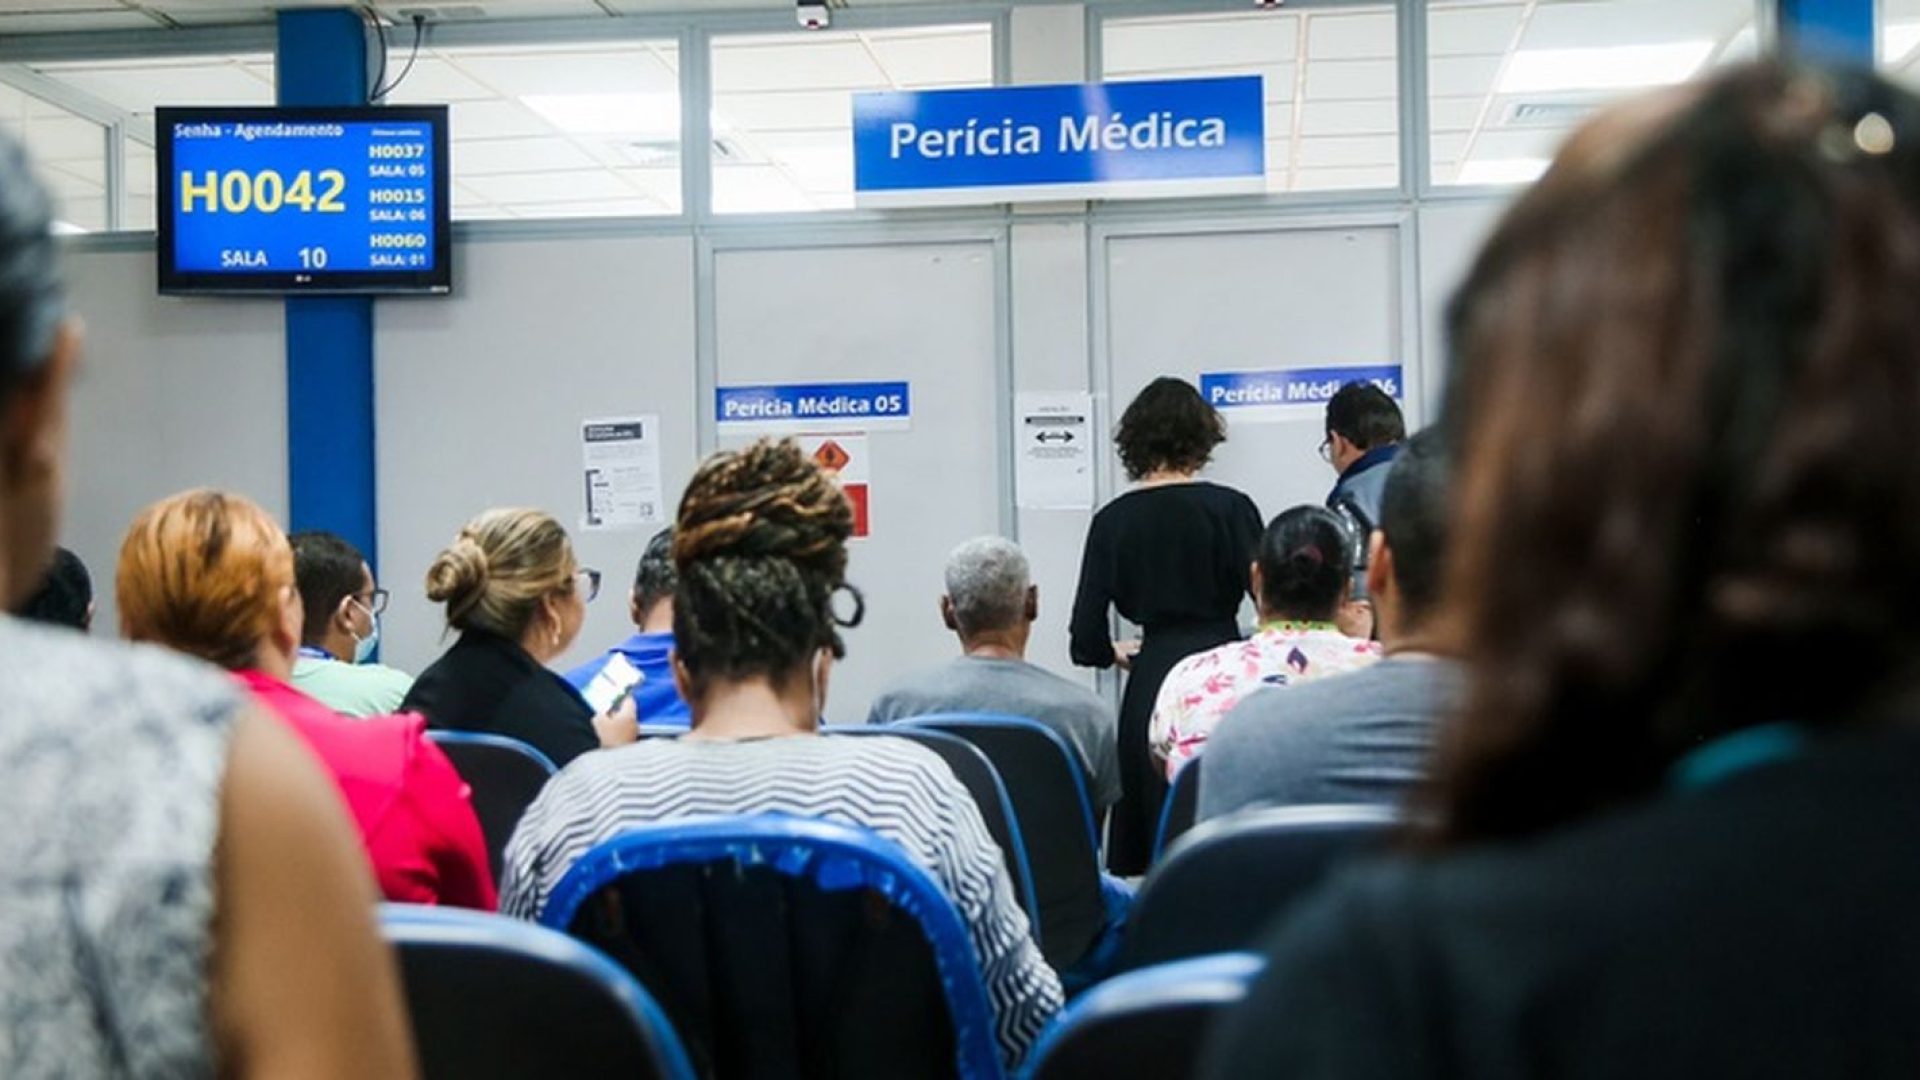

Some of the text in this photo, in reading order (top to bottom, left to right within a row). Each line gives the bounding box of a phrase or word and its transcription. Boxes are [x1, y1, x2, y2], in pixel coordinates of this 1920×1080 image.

[174, 123, 222, 138] Senha
[234, 123, 345, 141] Agendamento
[889, 110, 1226, 159] Perícia Médica
[369, 144, 425, 159] H0037
[369, 164, 426, 178] SALA: 05
[181, 169, 346, 213] H0042
[369, 189, 425, 204] H0015
[369, 209, 406, 222] SALA:
[369, 233, 427, 248] H0060
[220, 247, 328, 269] SALA 10
[370, 253, 406, 266] SALA:
[1211, 384, 1282, 403] Perícia
[797, 395, 870, 415] Médica
[874, 394, 902, 413] 05
